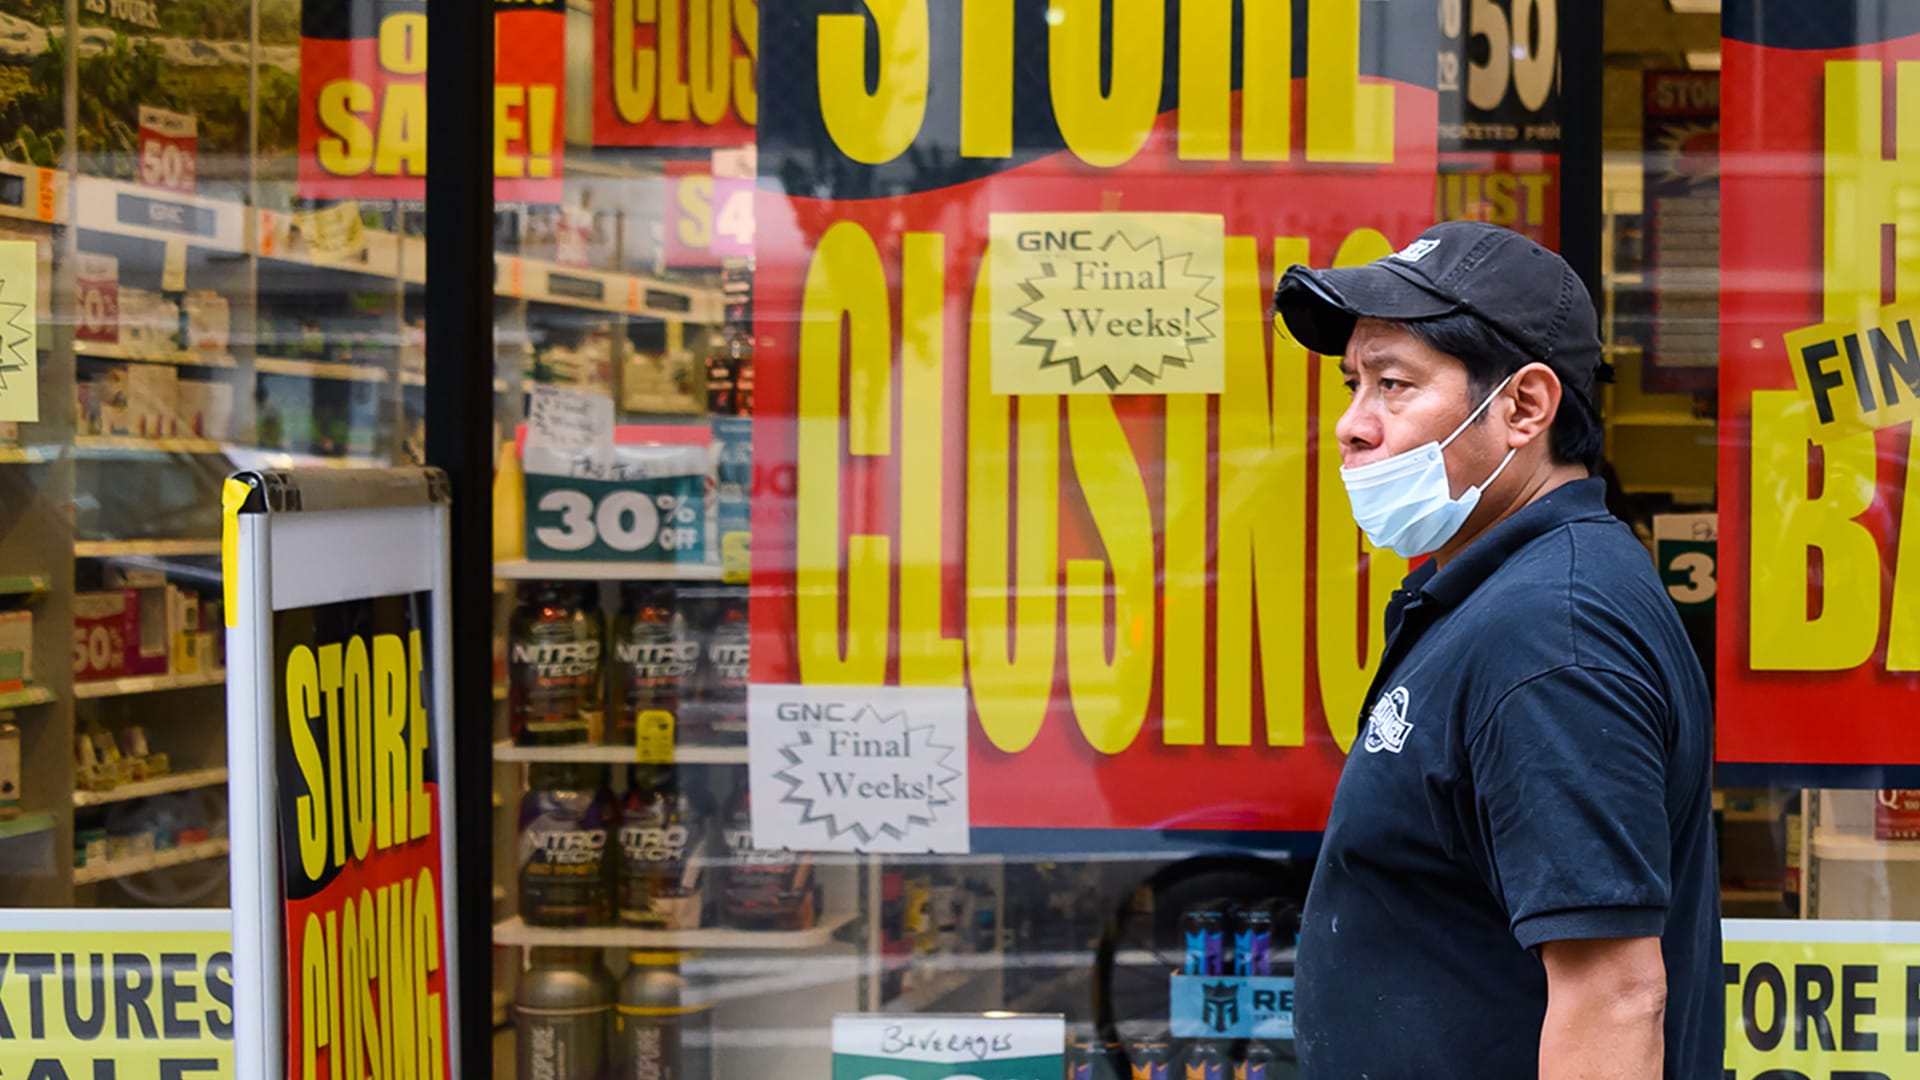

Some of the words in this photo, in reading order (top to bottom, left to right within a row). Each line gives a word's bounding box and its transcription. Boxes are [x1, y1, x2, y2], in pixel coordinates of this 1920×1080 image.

[1016, 230, 1093, 252] GNC
[1072, 260, 1168, 292] Final
[1062, 307, 1192, 338] Weeks!
[1801, 319, 1920, 425] FIN
[658, 527, 698, 551] OFF
[1668, 551, 1717, 604] 3
[512, 641, 600, 665] NITRO
[615, 641, 701, 665] NITRO
[536, 663, 597, 678] TECH
[776, 702, 846, 722] GNC
[286, 630, 433, 881] STORE
[827, 731, 912, 759] Final
[816, 771, 935, 801] Weeks!
